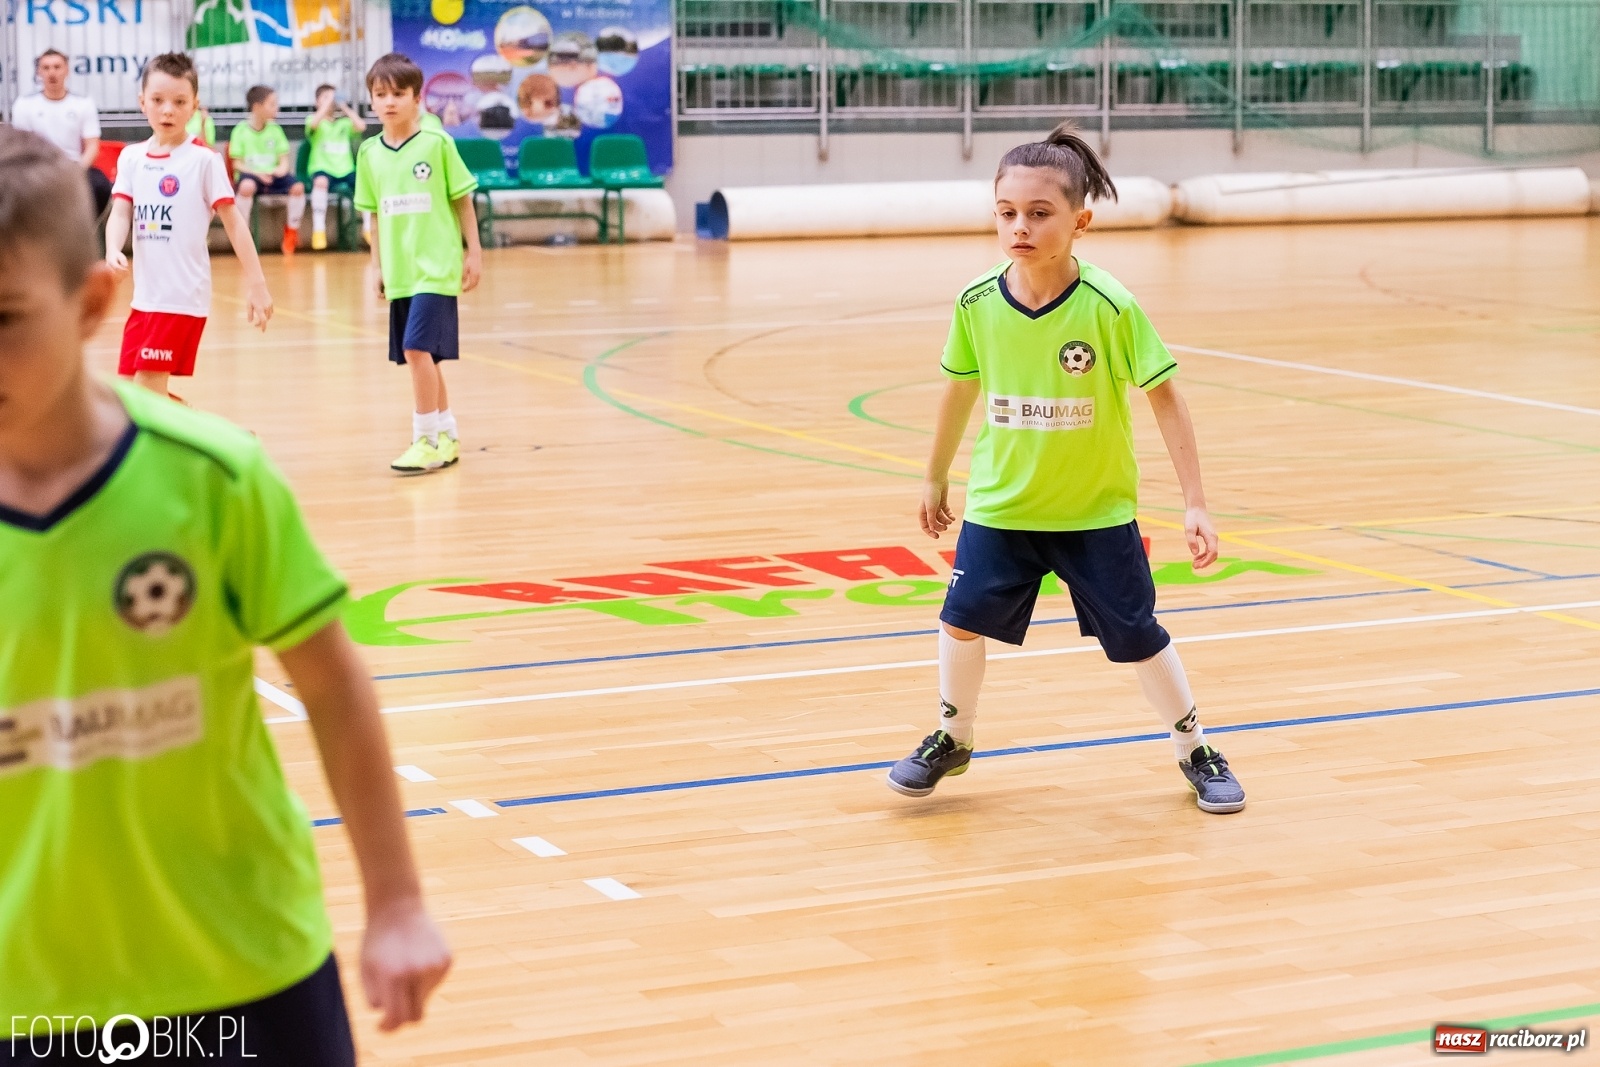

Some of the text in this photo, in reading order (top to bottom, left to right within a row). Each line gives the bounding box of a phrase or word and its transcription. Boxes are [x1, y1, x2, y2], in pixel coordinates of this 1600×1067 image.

[8, 0, 142, 24] RSKI
[134, 204, 173, 221] MYK
[140, 347, 174, 362] CMYK
[1022, 404, 1093, 418] BAUMAG
[1046, 419, 1092, 427] BUDOWLANA
